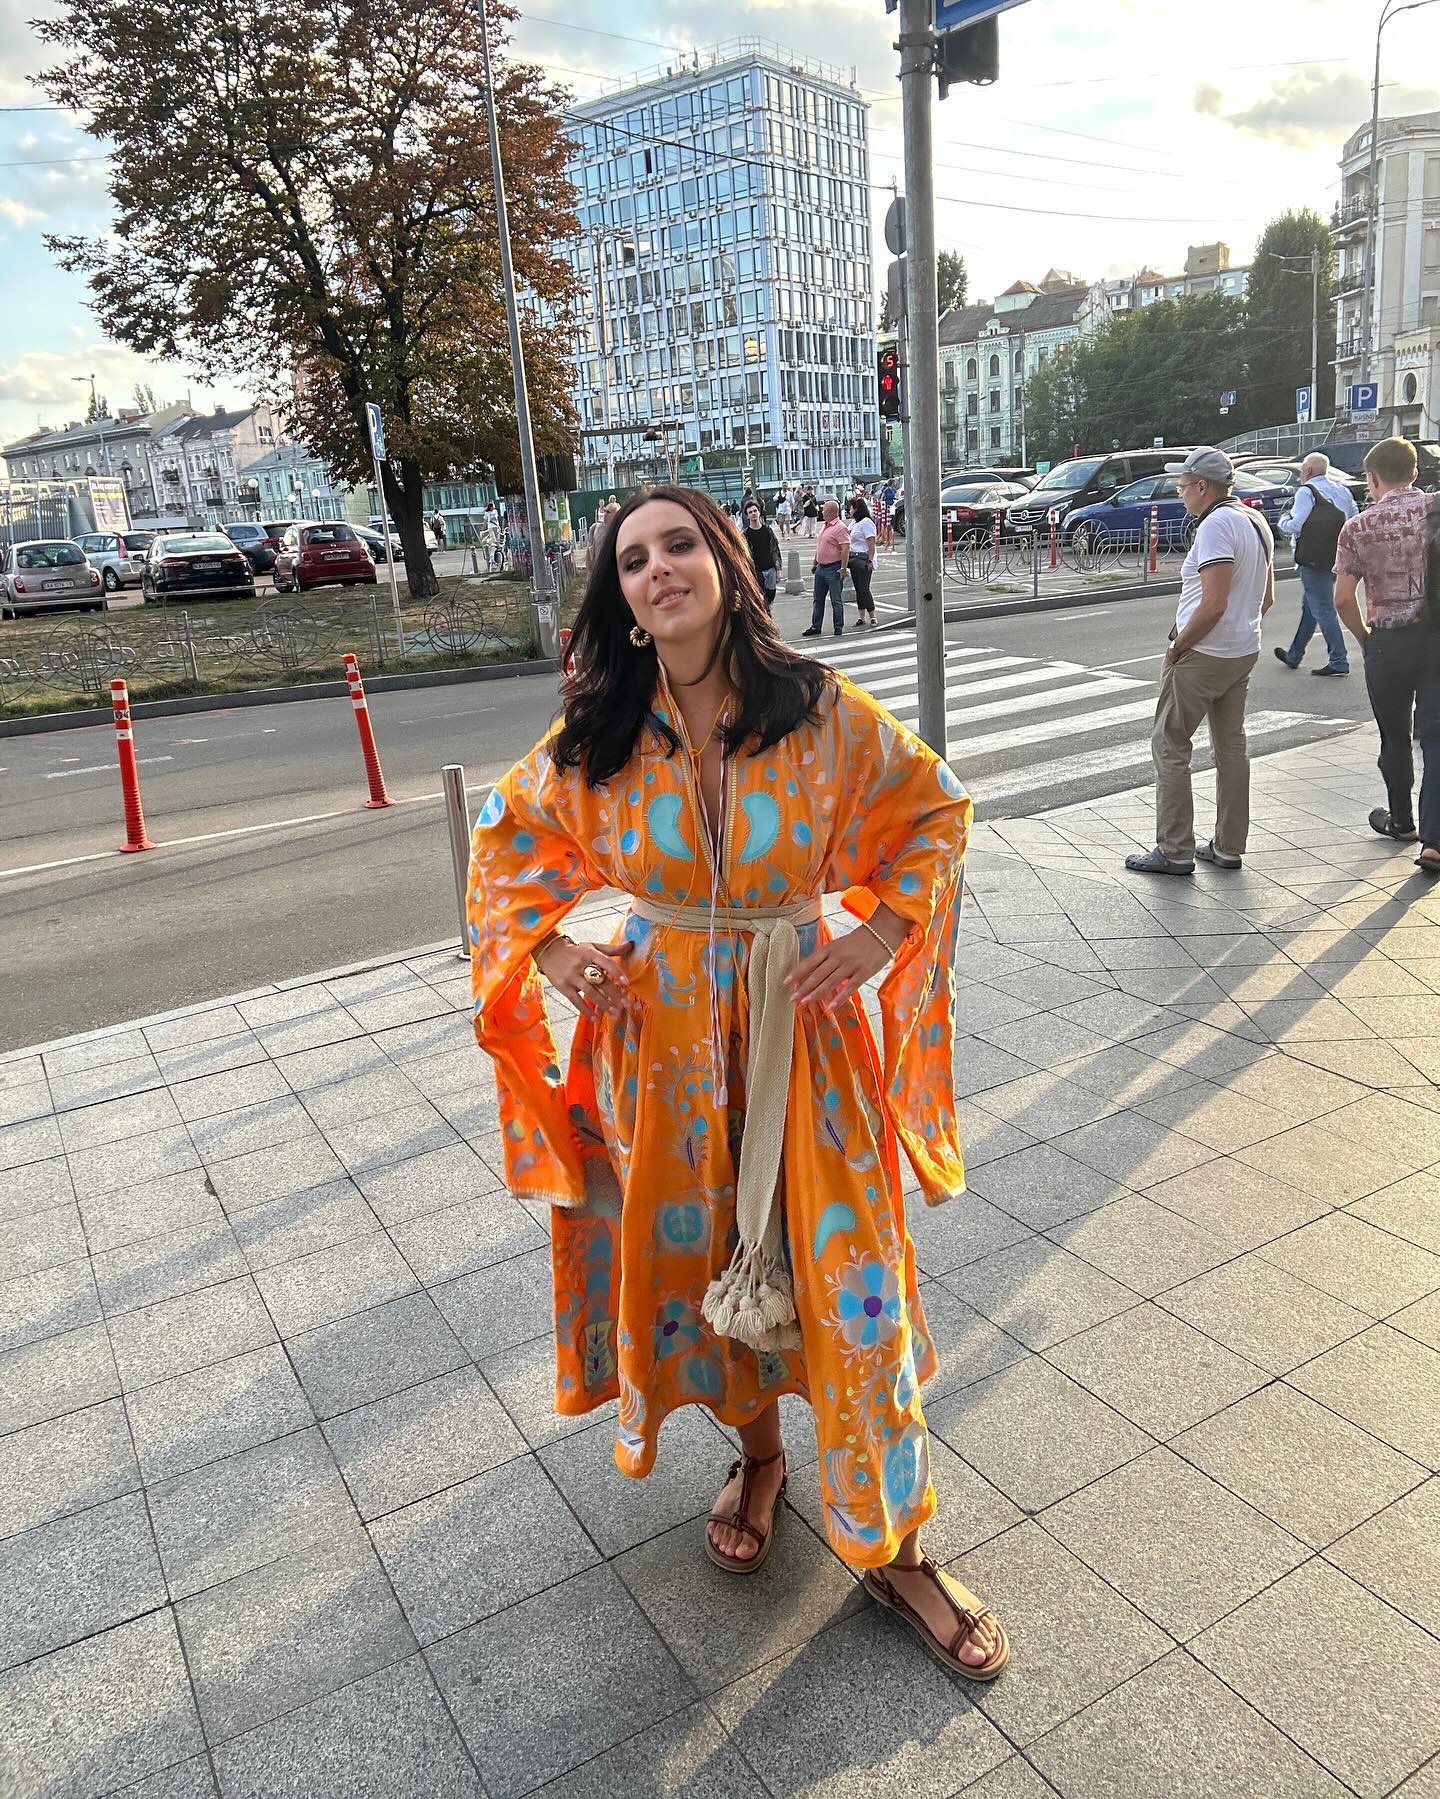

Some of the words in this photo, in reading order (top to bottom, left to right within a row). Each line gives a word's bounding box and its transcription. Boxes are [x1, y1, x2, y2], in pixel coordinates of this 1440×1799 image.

[886, 355, 894, 367] 5
[1299, 391, 1308, 410] P
[1357, 386, 1373, 408] P
